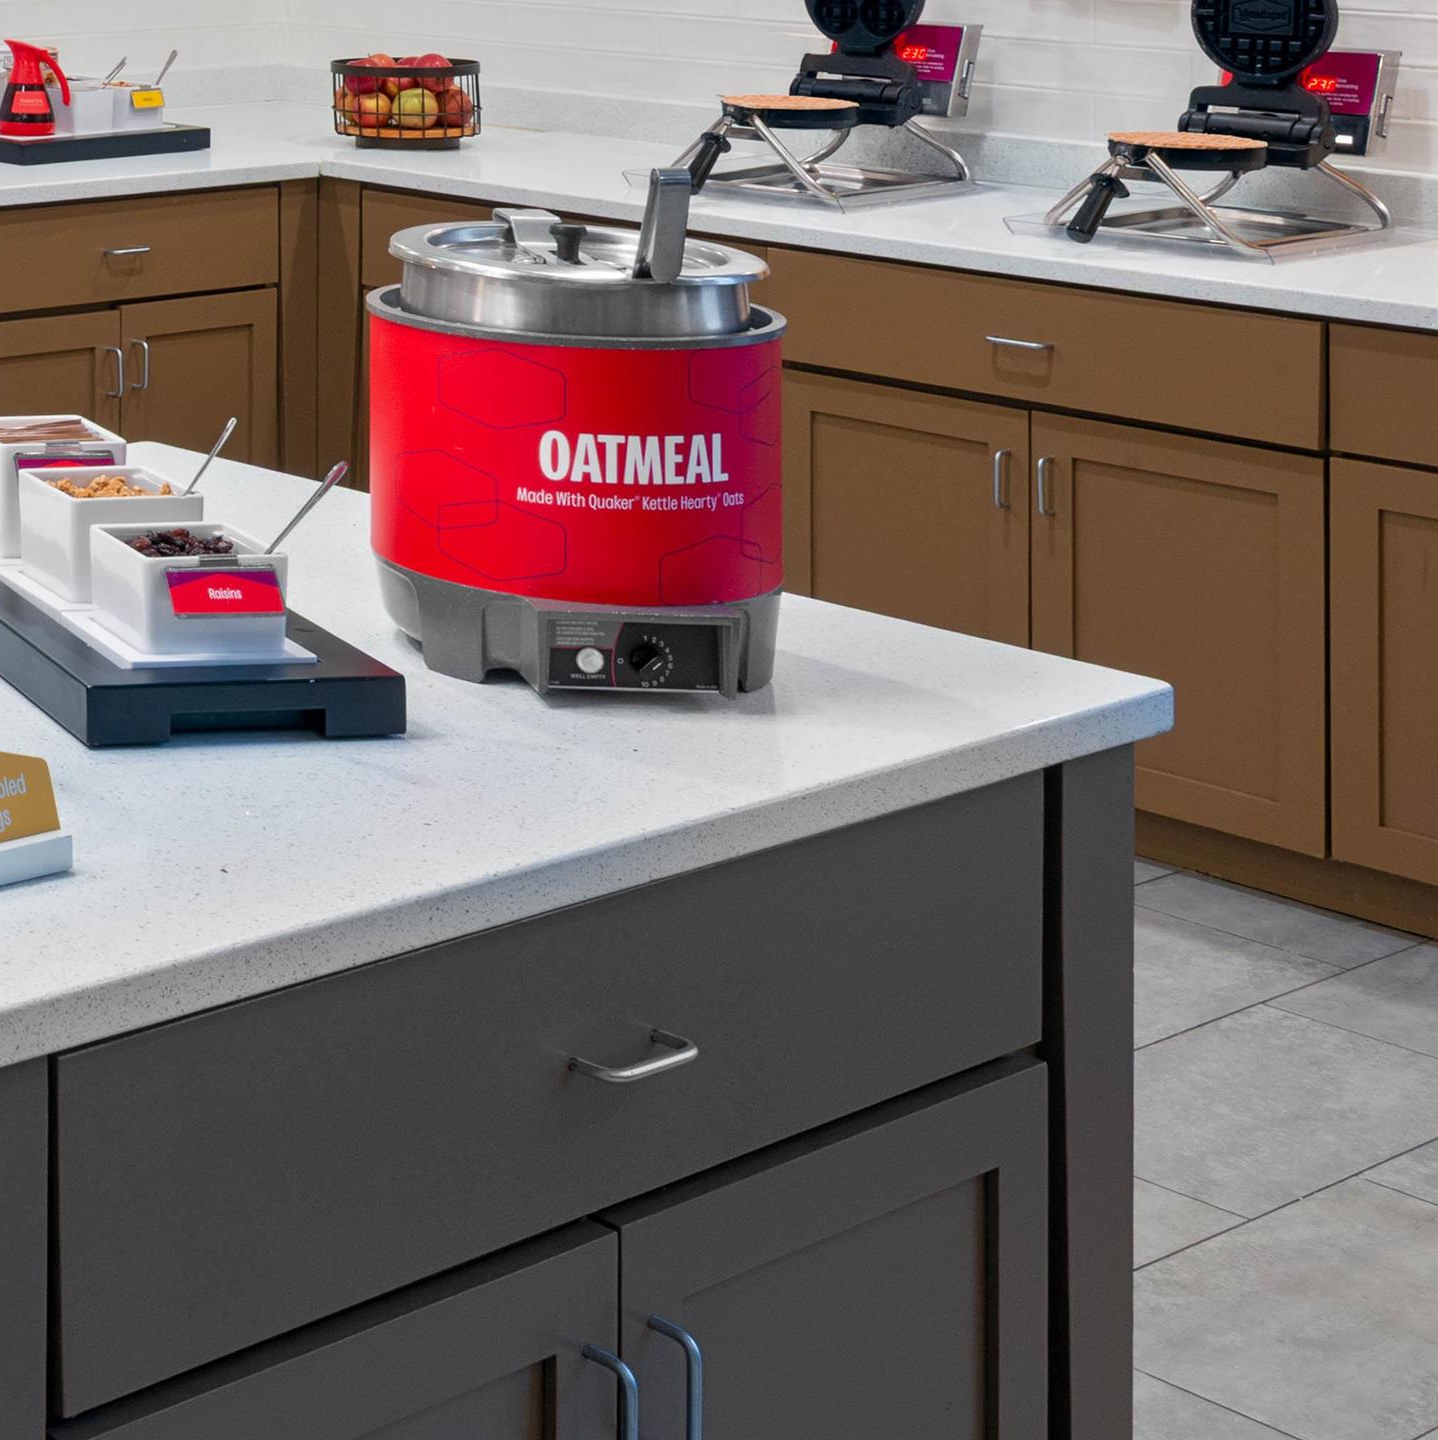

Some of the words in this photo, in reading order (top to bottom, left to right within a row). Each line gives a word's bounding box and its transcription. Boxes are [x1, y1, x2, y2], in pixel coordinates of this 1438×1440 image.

[539, 430, 729, 485] OATMEAL
[516, 486, 553, 505] Made
[555, 491, 586, 508] With
[642, 495, 678, 511] Kettle
[723, 491, 744, 506] Oats
[207, 587, 242, 599] Raisins
